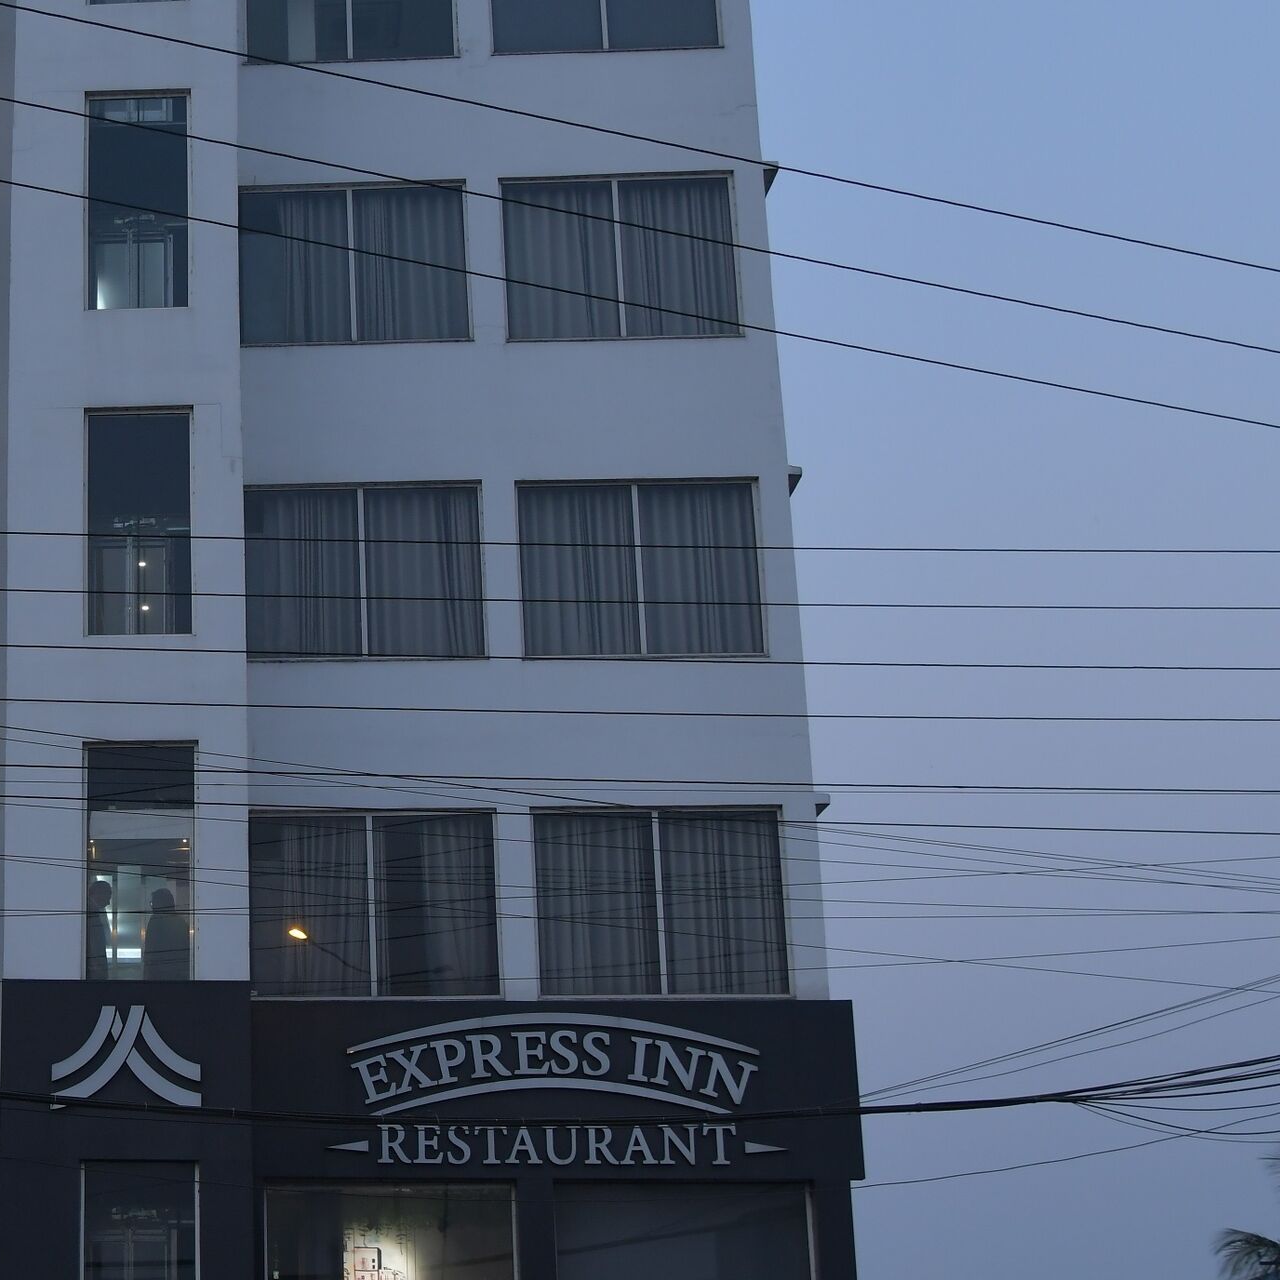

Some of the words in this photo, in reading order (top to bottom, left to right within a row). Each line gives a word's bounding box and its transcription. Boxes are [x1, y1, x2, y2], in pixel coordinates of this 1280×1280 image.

[350, 1030, 611, 1106] EXPRESS
[627, 1035, 759, 1106] INN
[377, 1123, 737, 1167] RESTAURANT
